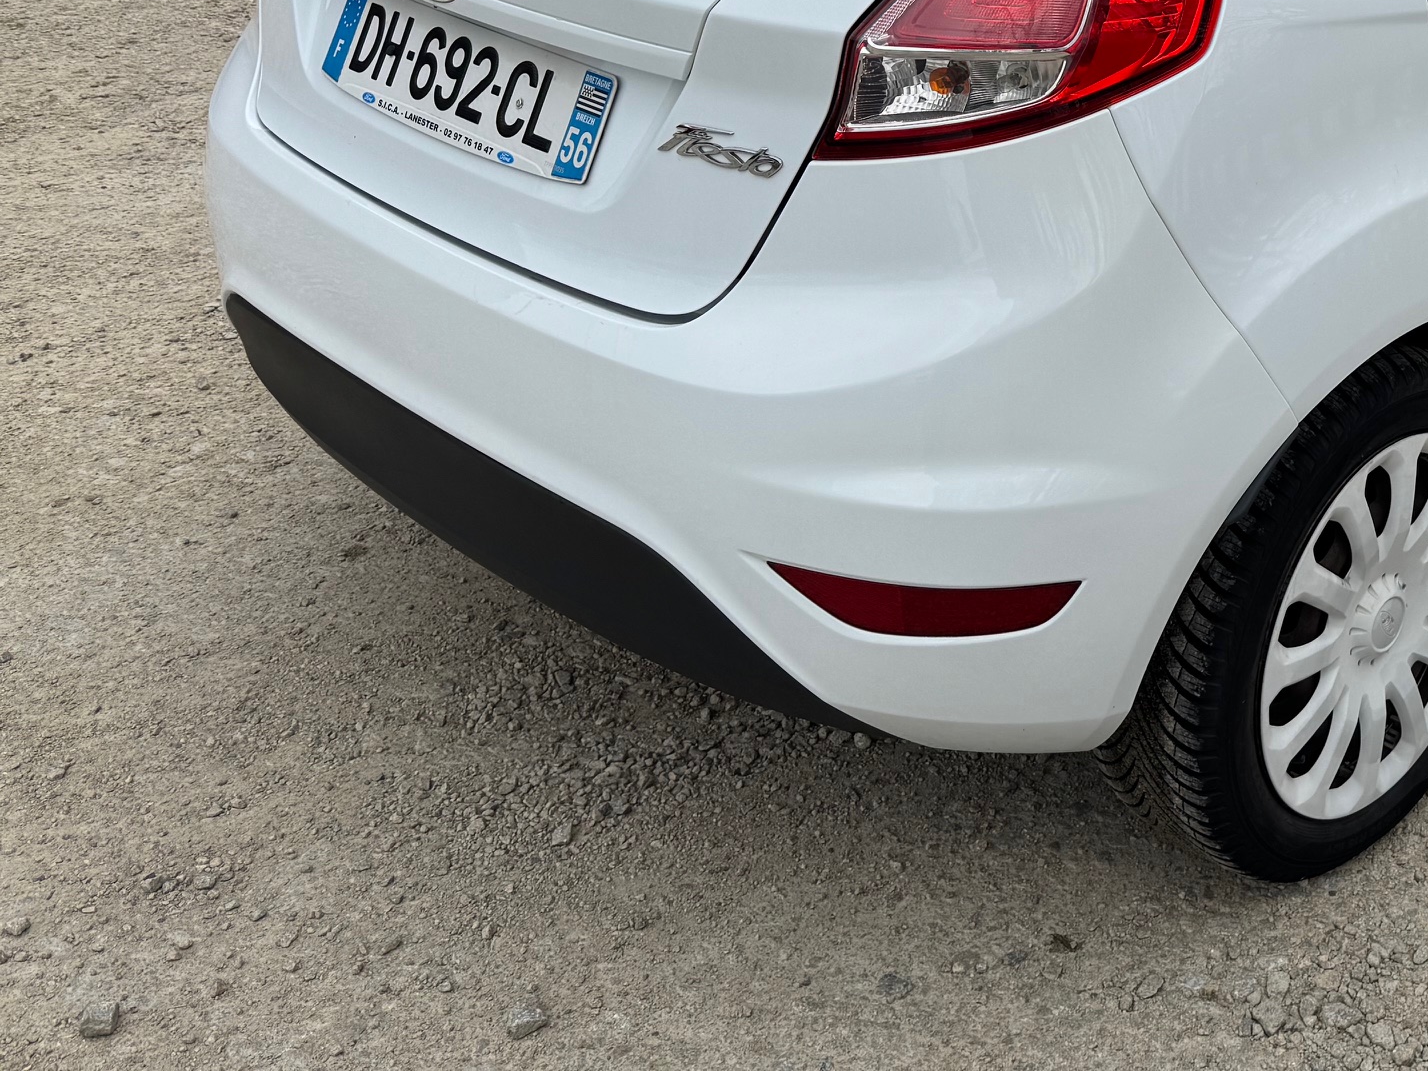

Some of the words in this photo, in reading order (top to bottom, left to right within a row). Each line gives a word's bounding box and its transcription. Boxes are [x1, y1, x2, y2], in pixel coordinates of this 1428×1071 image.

[332, 38, 345, 58] F
[348, 2, 554, 154] DH-692-CL
[584, 73, 612, 90] BRETAGNE
[377, 99, 399, 115] S.I.C.A.
[404, 111, 439, 132] LANESTER
[443, 128, 453, 138] 02
[453, 132, 463, 142] 97
[463, 136, 473, 147] 76
[474, 141, 483, 151] 18
[483, 146, 494, 155] 47
[575, 112, 596, 126] BREIZH
[559, 126, 593, 169] 56
[657, 122, 784, 179] Fiesta
